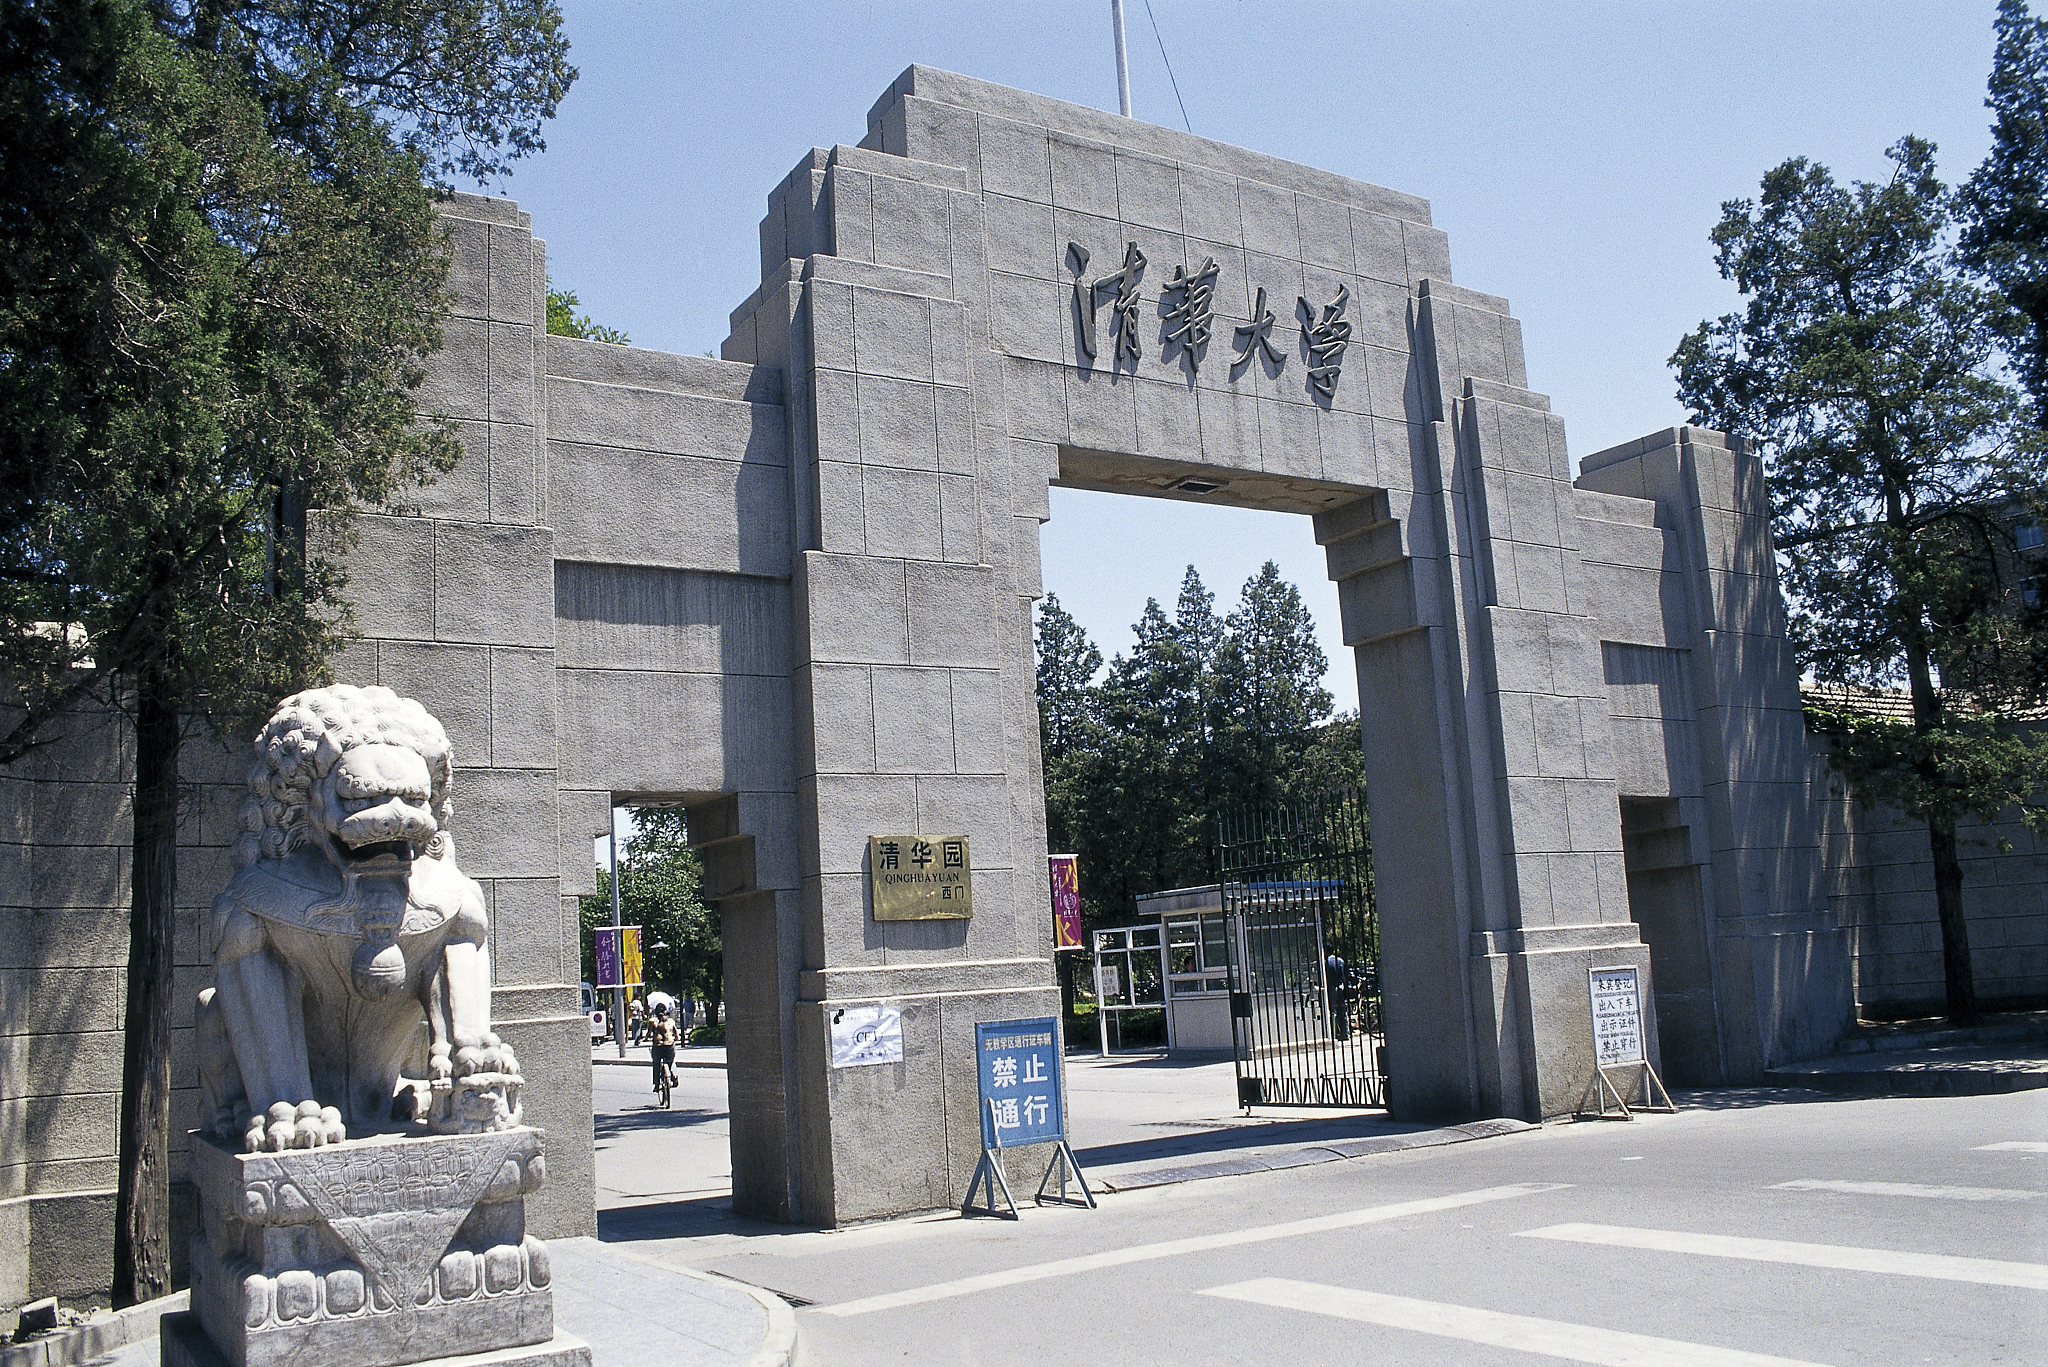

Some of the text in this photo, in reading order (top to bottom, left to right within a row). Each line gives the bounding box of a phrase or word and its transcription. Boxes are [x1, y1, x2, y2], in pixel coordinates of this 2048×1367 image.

[879, 841, 964, 870] 清华园
[885, 873, 960, 884] QINGHUAYUAN
[942, 886, 964, 899] 西门
[1599, 997, 1632, 1012] 出入下车
[1601, 1017, 1636, 1032] 出示证件
[1602, 1037, 1637, 1053] 禁止穿行
[992, 1054, 1048, 1088] 禁止
[994, 1095, 1049, 1129] 通行
